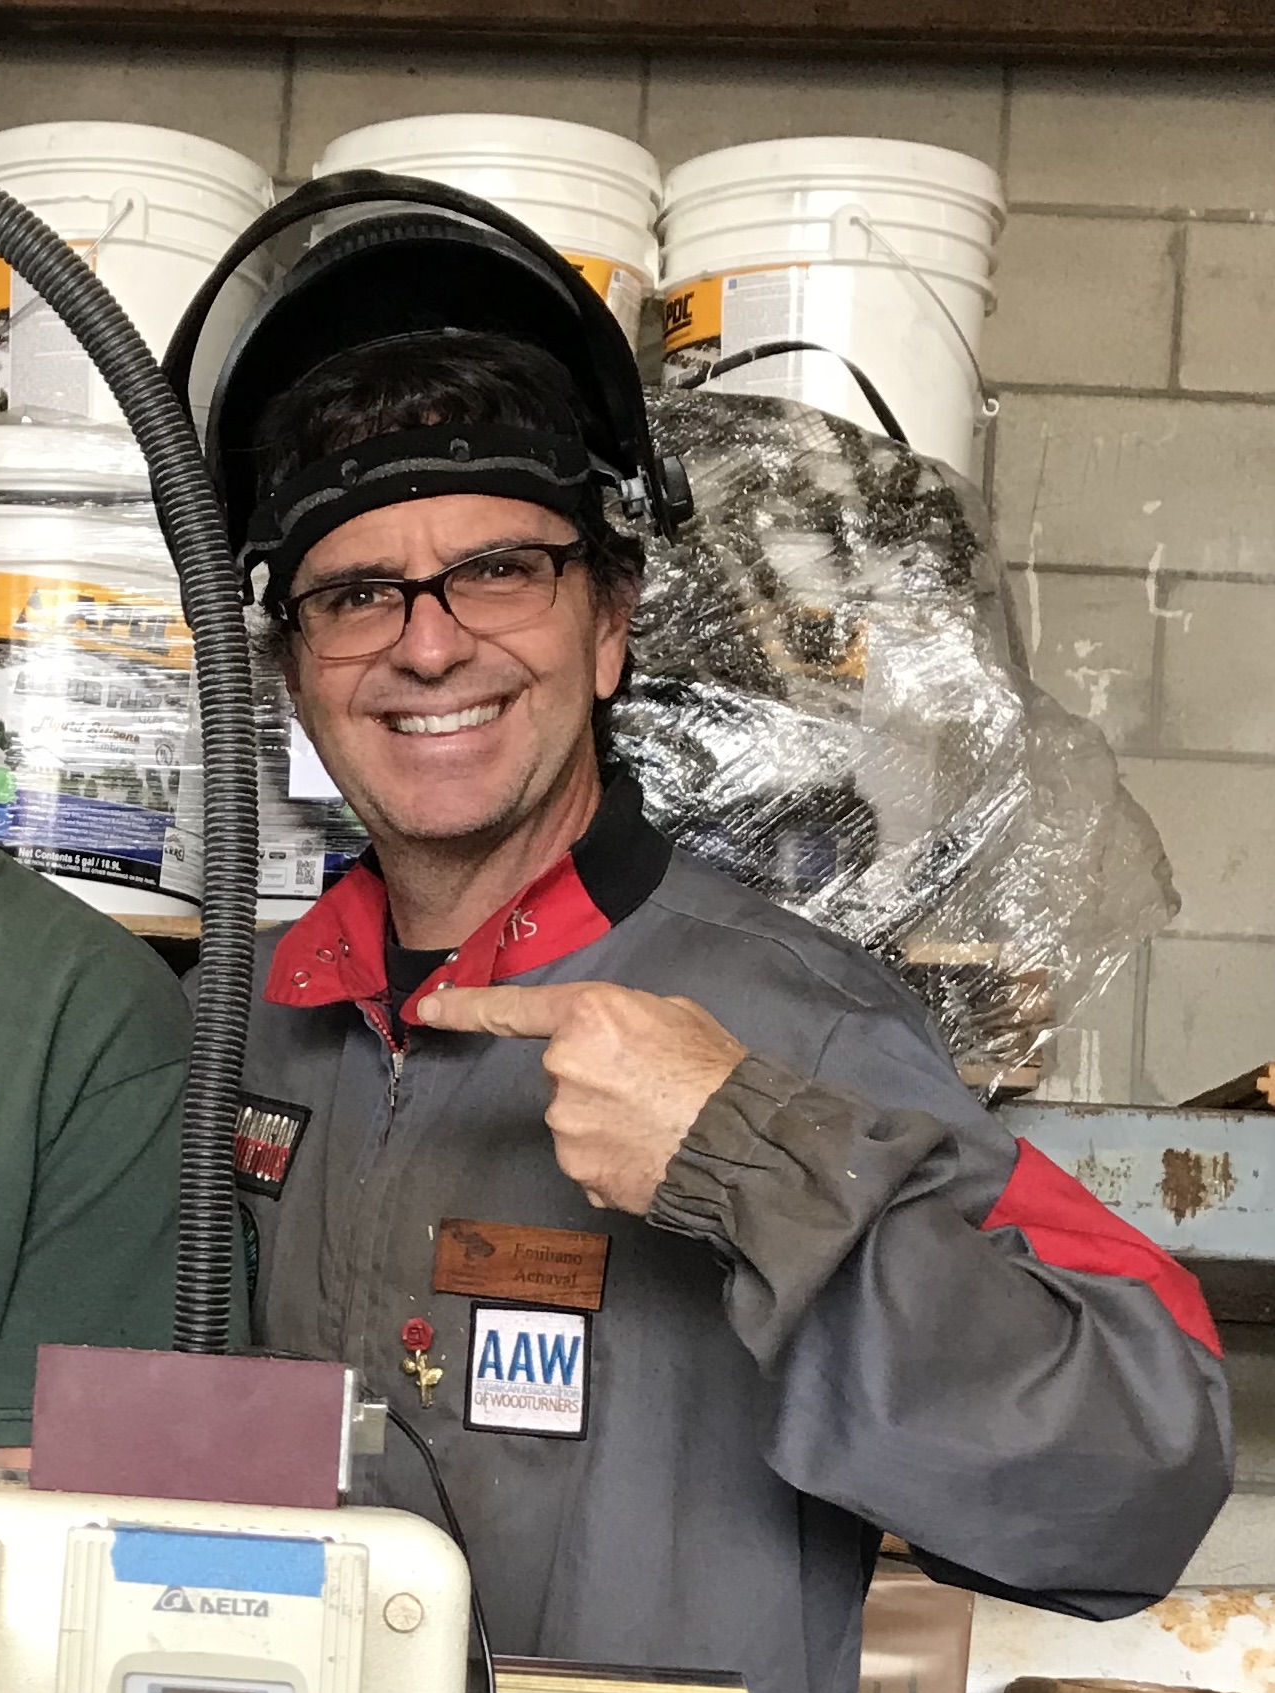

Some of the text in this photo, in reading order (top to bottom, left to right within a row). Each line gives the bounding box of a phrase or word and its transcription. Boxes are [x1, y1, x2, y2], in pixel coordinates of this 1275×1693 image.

[18, 847, 33, 858] Net
[35, 849, 73, 863] Contents
[74, 854, 80, 864] 5
[81, 855, 95, 867] gal
[476, 1329, 582, 1386] AAW
[489, 1392, 579, 1413] WOODTURNERS
[200, 1596, 270, 1617] DELTA
